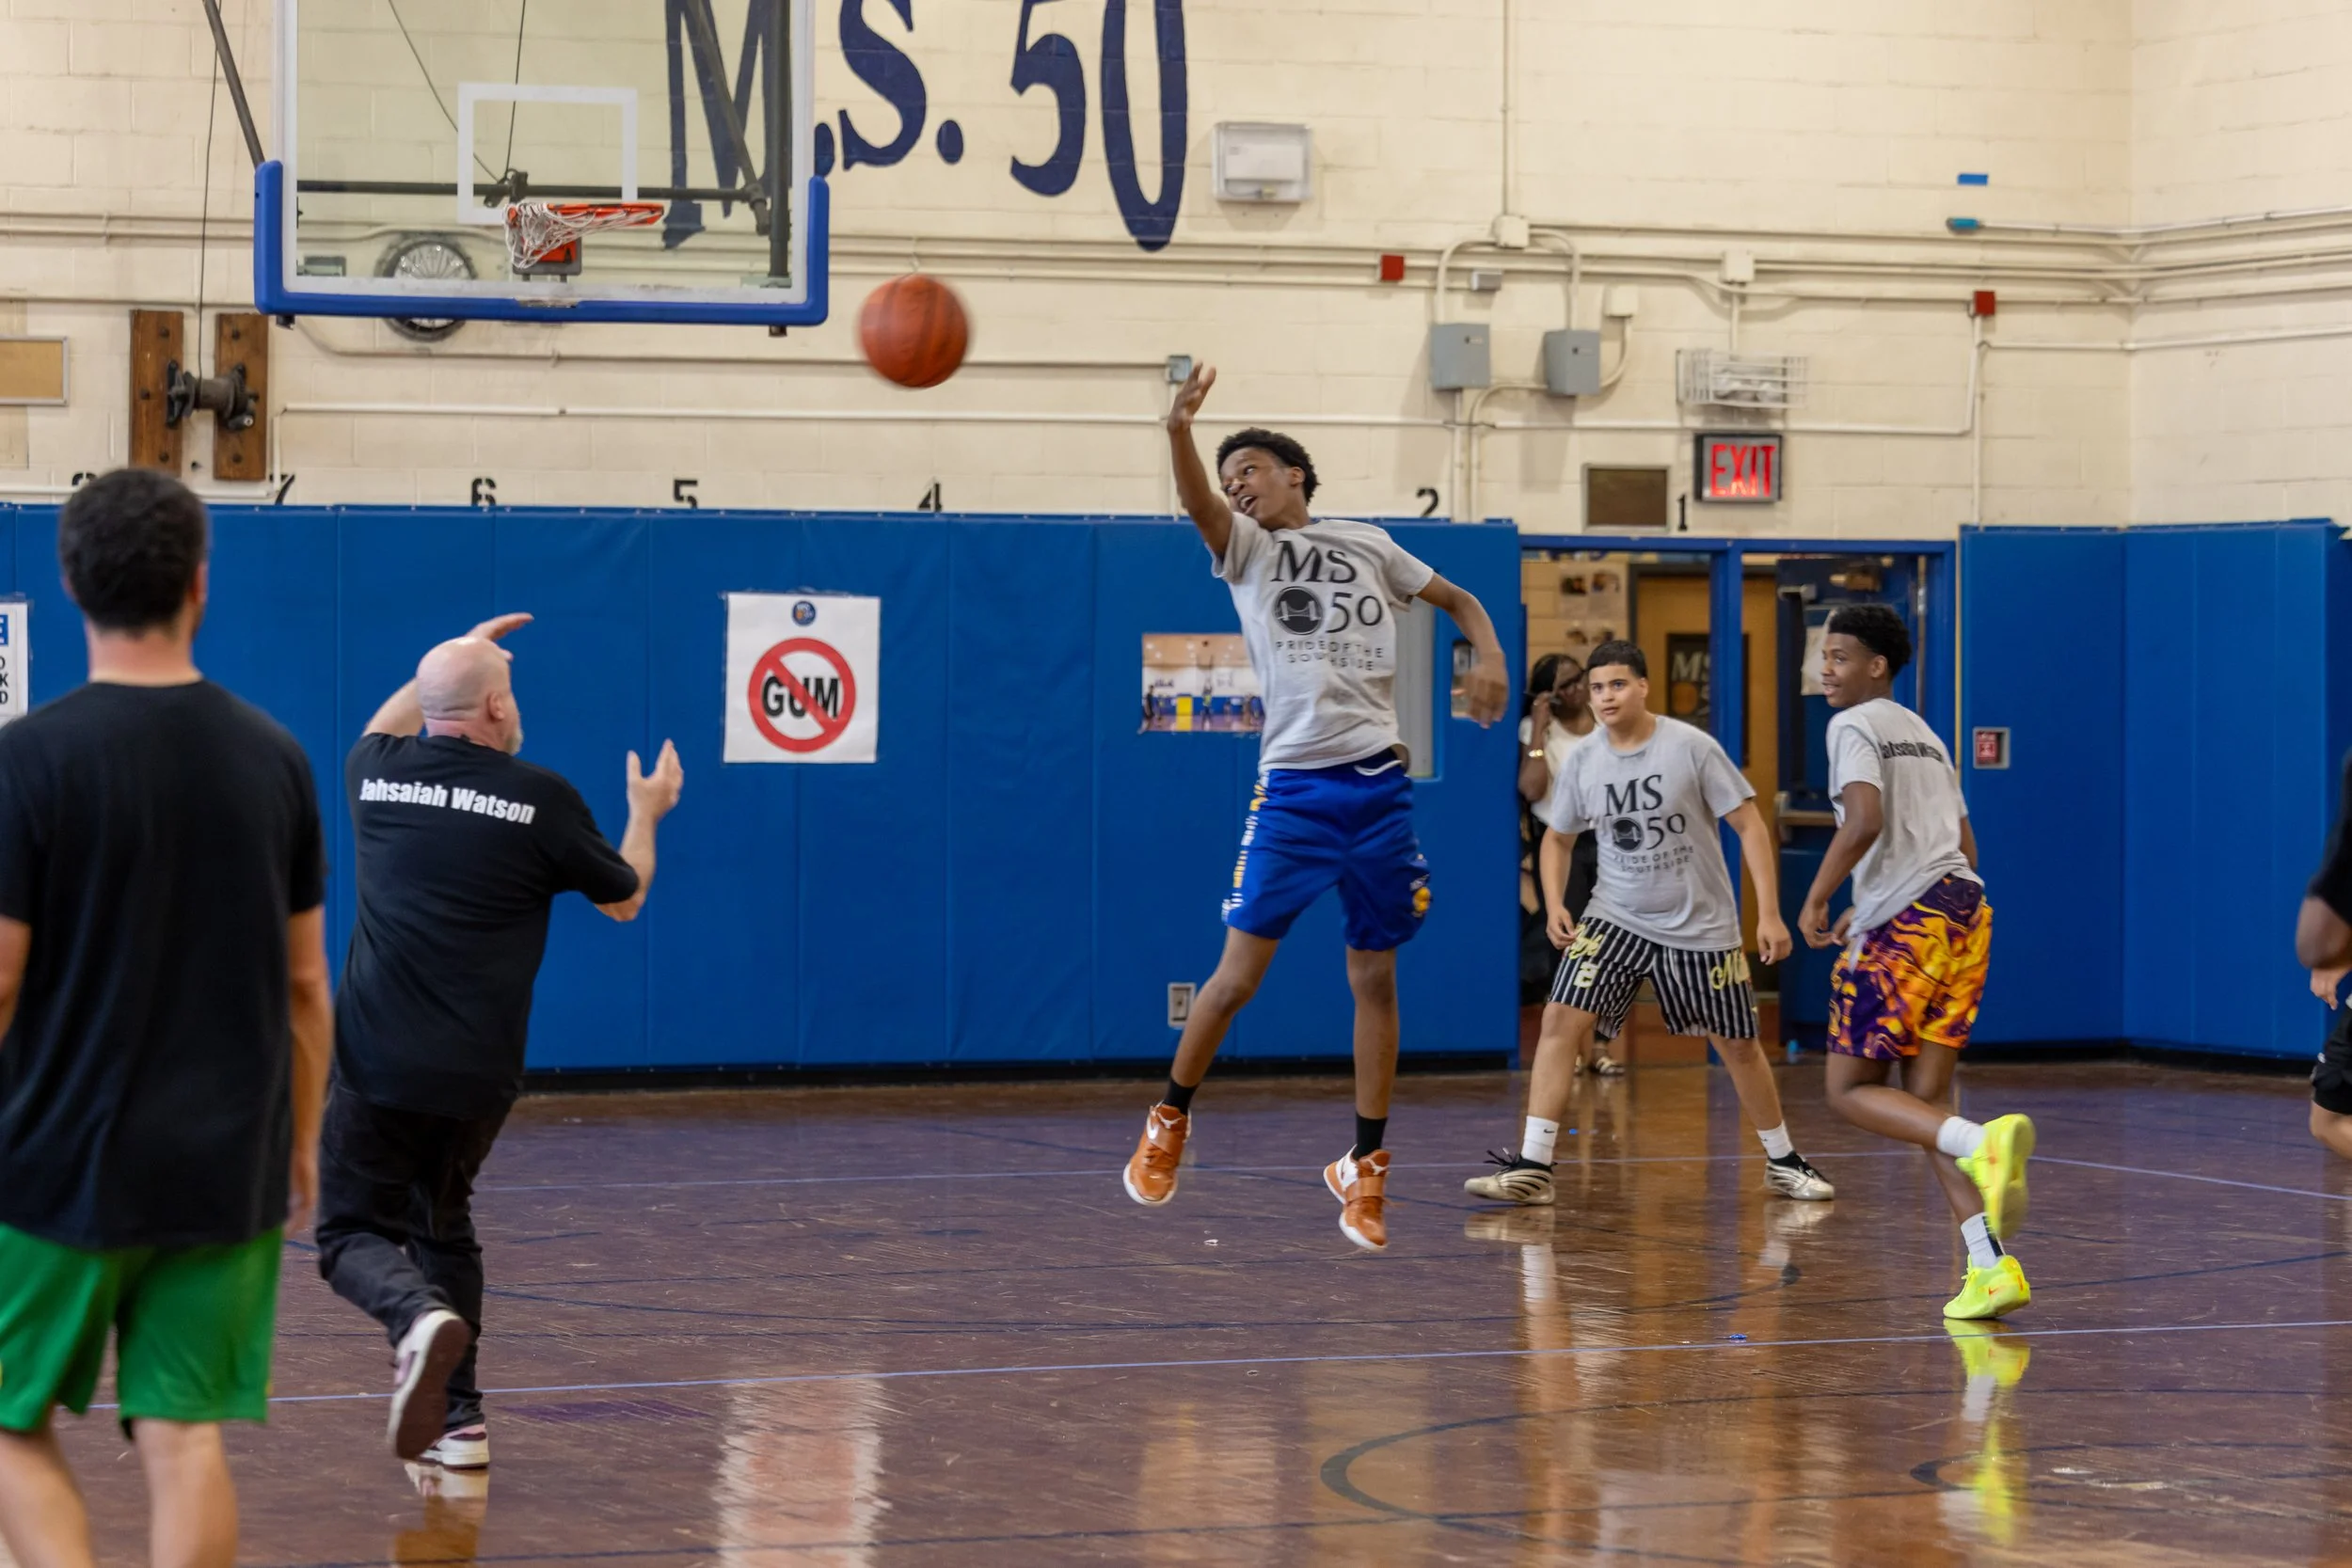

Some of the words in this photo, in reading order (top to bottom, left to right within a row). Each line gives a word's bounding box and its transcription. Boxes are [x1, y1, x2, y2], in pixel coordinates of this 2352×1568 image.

[1010, 0, 1186, 251] 50
[269, 473, 295, 505] 7
[1710, 443, 1776, 497] EXIT
[471, 478, 497, 506] 6
[673, 479, 699, 509] 5
[917, 483, 942, 511] 4
[1417, 487, 1439, 517] 2
[1677, 494, 1688, 531] 1
[1270, 540, 1358, 584] MS
[1325, 592, 1383, 633] 50
[760, 675, 840, 719] GUM
[359, 778, 449, 808] Jahsaiah
[451, 786, 536, 825] Watson
[1603, 773, 1663, 817] MS
[1645, 813, 1686, 851] 50
